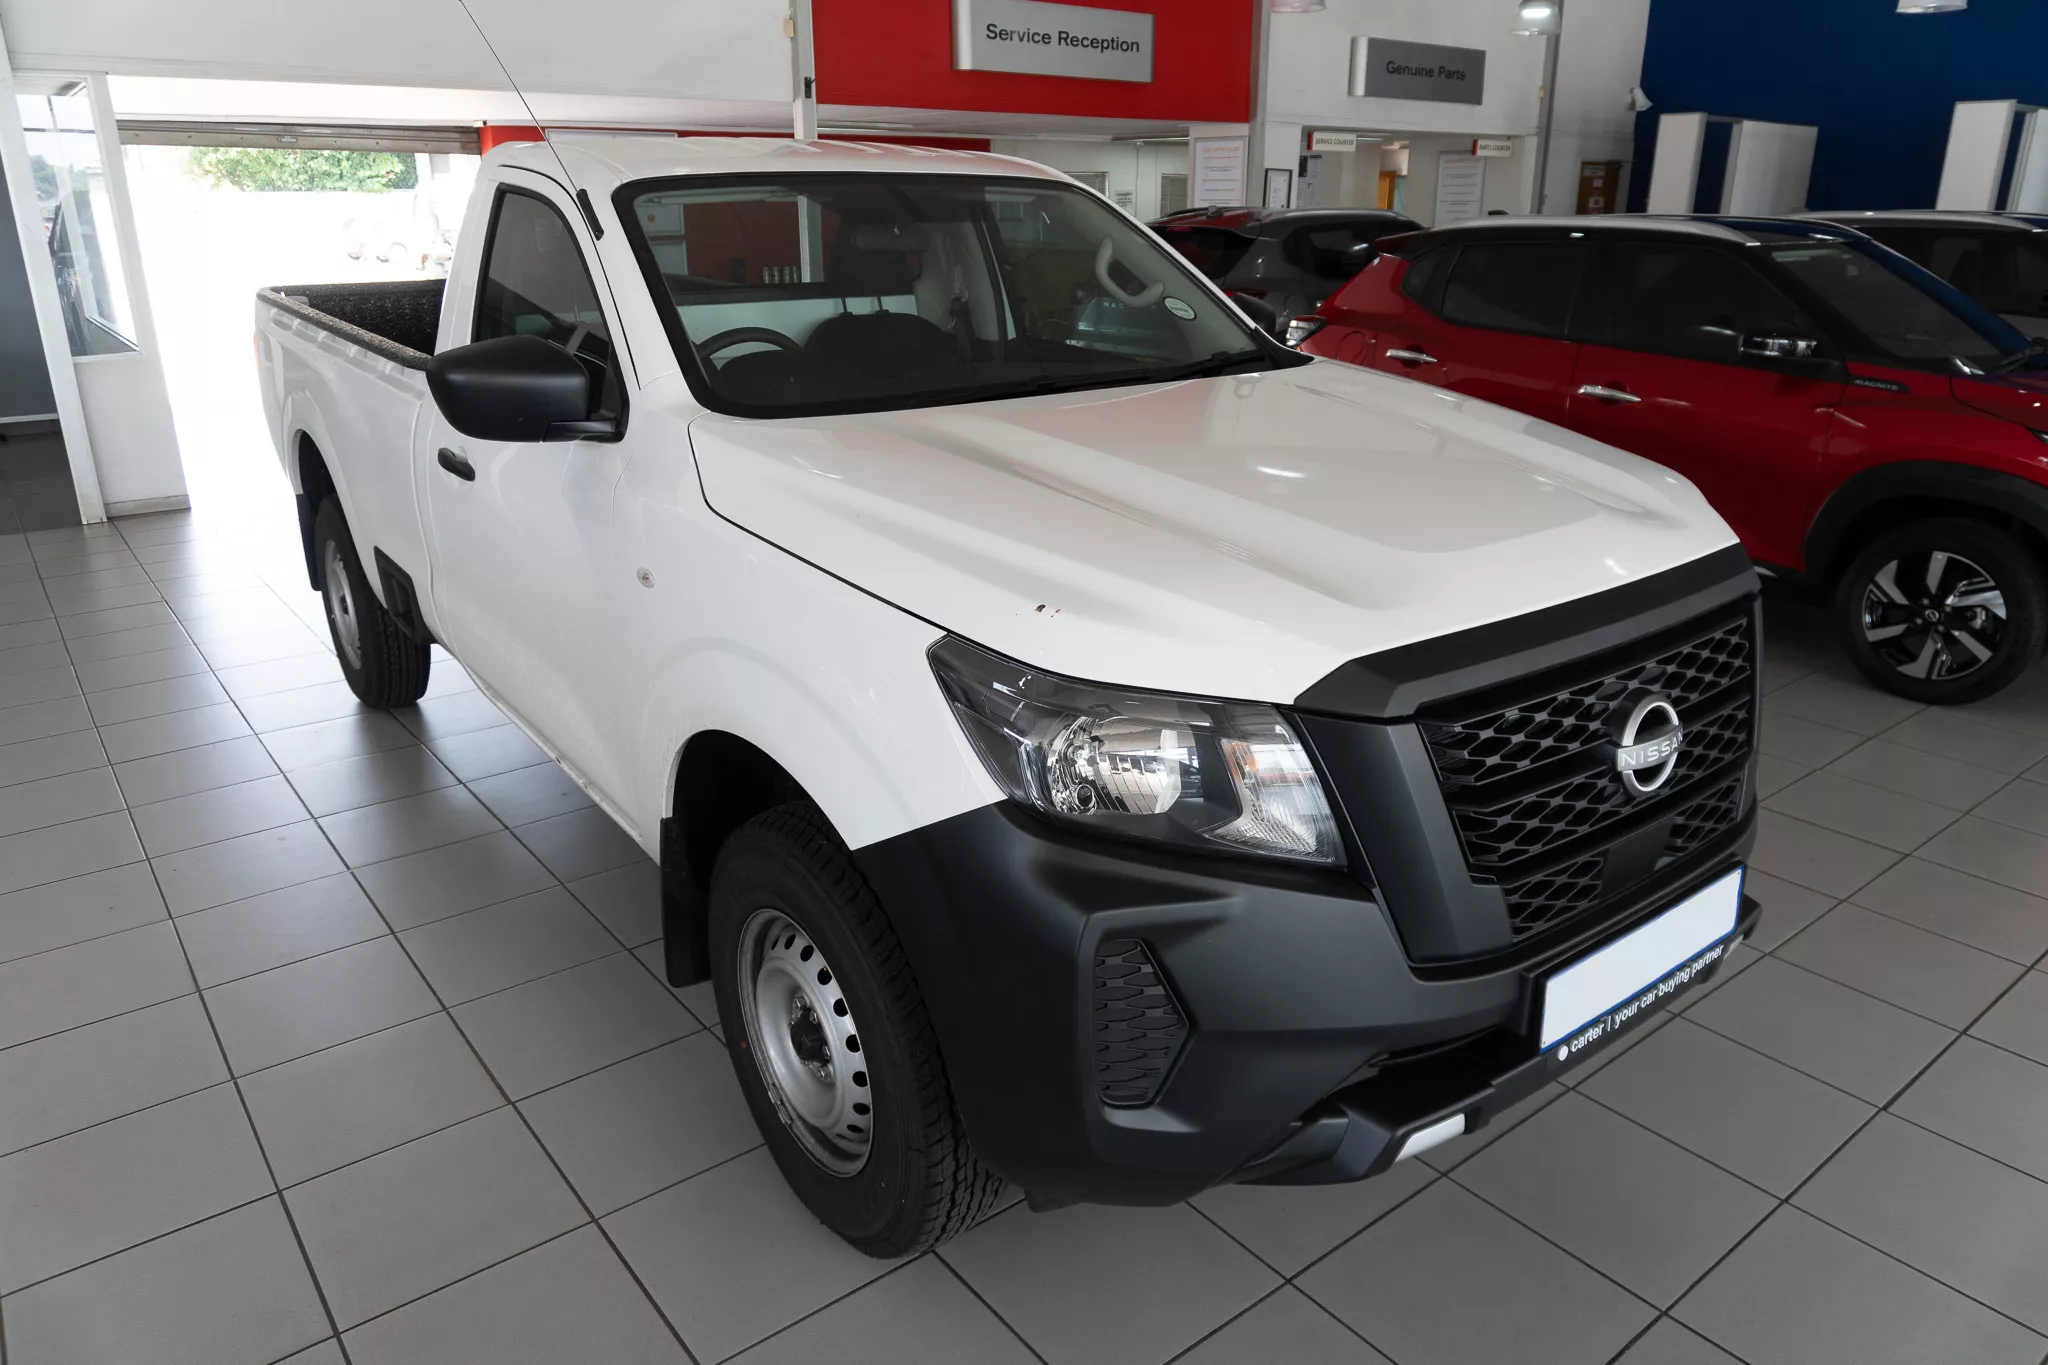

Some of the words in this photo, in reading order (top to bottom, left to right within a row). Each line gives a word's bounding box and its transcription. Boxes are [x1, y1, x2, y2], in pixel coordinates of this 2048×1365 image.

[986, 23, 1052, 45] Service
[1058, 30, 1140, 53] Reception
[1386, 60, 1435, 78] Genuine
[1438, 65, 1466, 81] Parts
[1315, 137, 1333, 145] SERVICE
[1334, 138, 1355, 146] COUNTER
[1621, 731, 1683, 767] NISSAN
[1571, 1023, 1604, 1053] carter
[1614, 1002, 1640, 1029] your
[1640, 989, 1658, 1009] car
[1658, 967, 1690, 998] buying
[1691, 944, 1724, 978] partner
